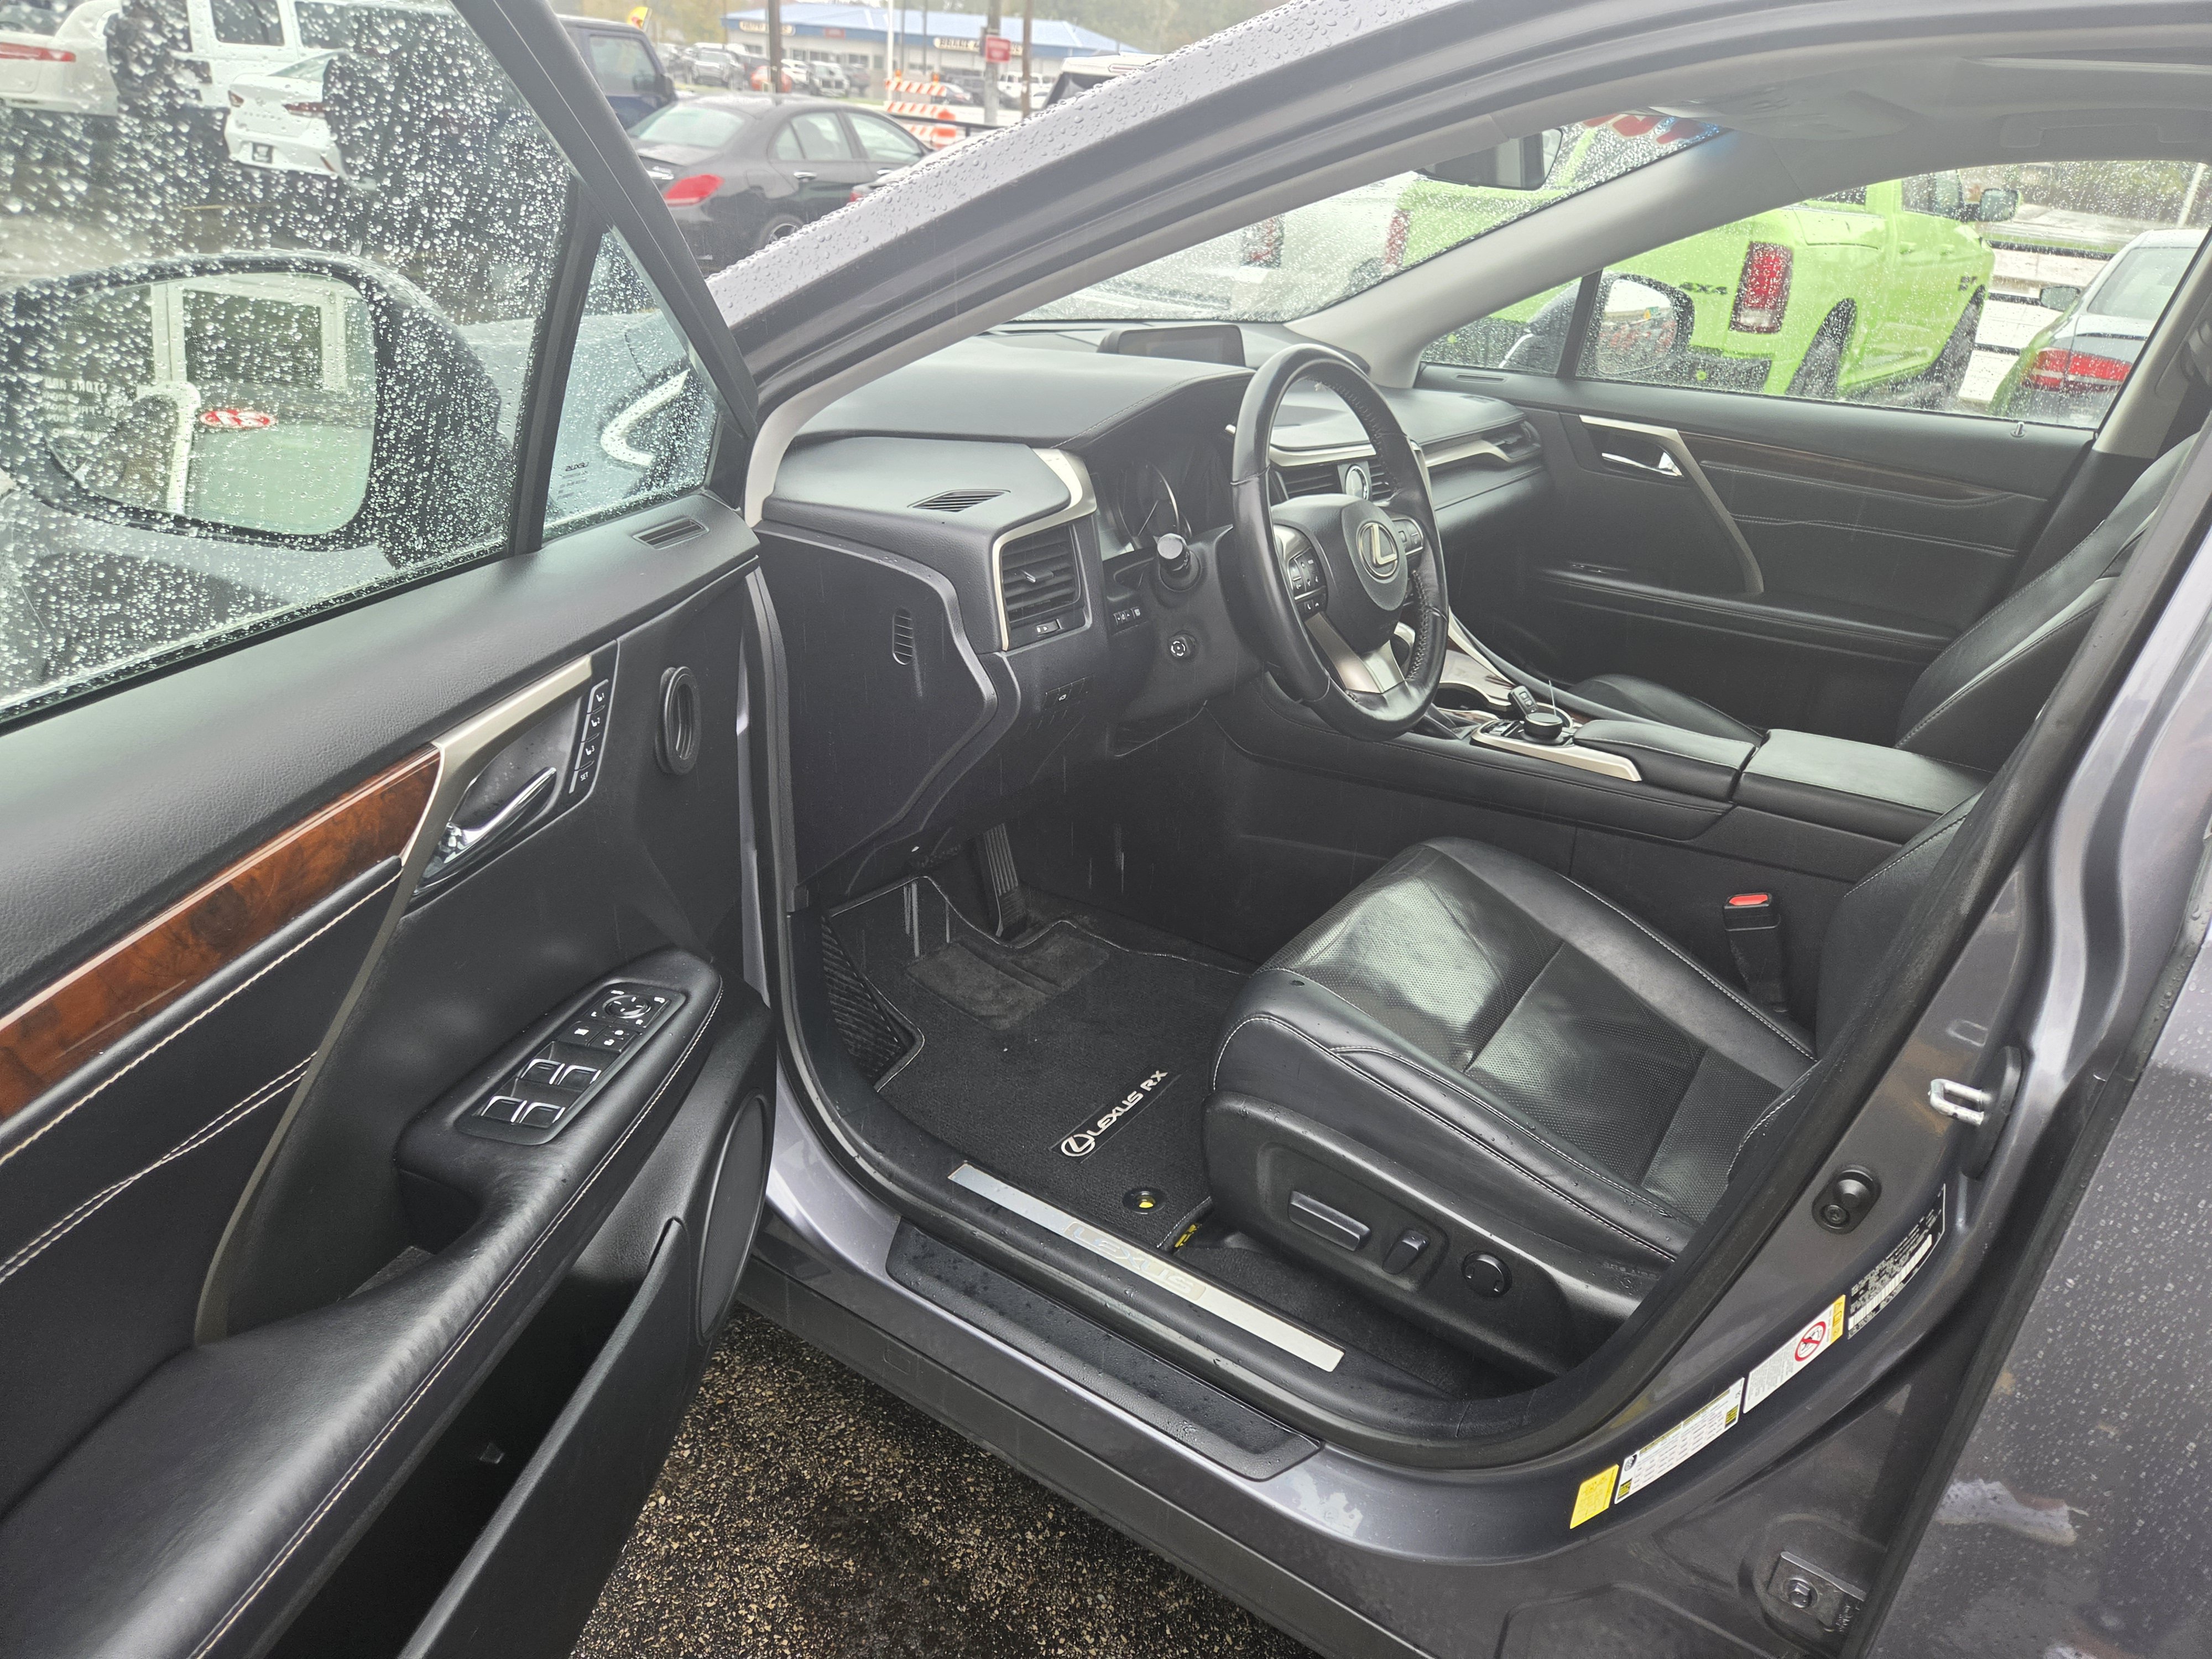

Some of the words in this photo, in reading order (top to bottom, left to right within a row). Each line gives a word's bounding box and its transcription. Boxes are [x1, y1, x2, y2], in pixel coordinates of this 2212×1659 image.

[580, 771, 589, 781] SET
[1086, 1091, 1144, 1136] LEXUS
[1140, 1070, 1168, 1092] RX
[1072, 1227, 1194, 1294] LEXUS
